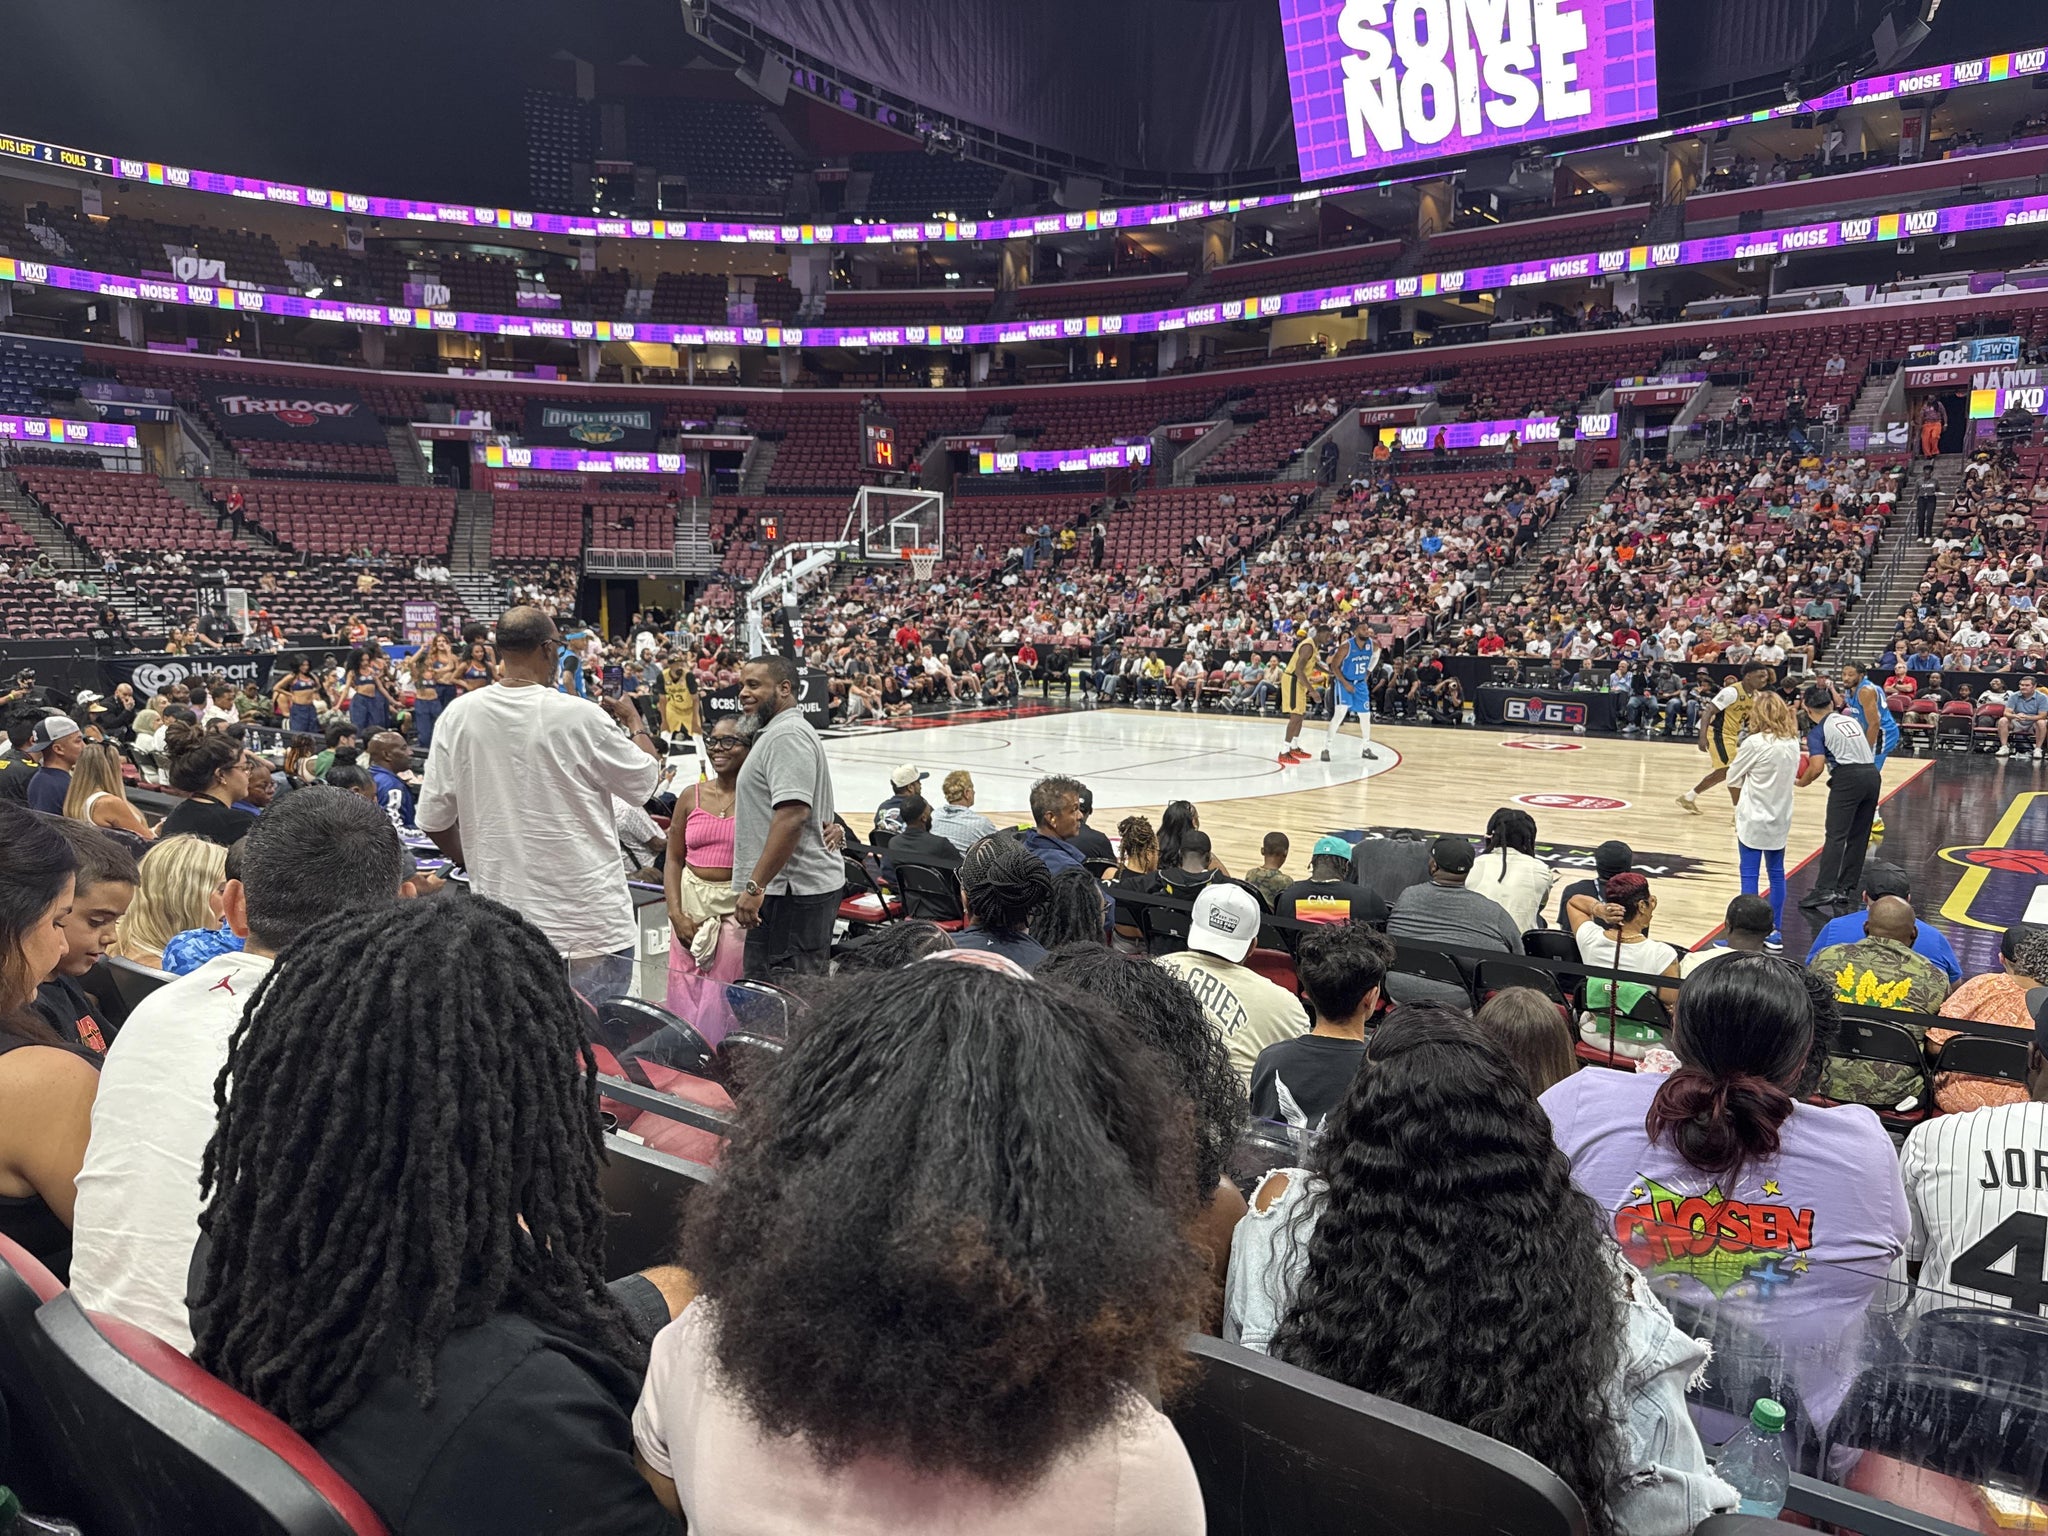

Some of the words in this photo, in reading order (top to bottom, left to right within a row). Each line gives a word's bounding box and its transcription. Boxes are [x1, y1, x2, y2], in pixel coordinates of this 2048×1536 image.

[1338, 0, 1588, 79] SOME
[2014, 51, 2046, 71] MXD
[1954, 61, 1983, 80] MXD
[1898, 73, 1942, 93] NOISE
[1343, 43, 1591, 158] NOISE
[16, 142, 35, 156] LEFT
[44, 147, 52, 161] 2
[61, 151, 86, 167] FOULS
[94, 158, 102, 171] 2
[120, 161, 143, 176] MXD
[167, 168, 189, 184] MXD
[267, 187, 300, 202] NOISE
[438, 208, 469, 222] NOISE
[1905, 211, 1937, 232] MXD
[1841, 219, 1871, 238] MXD
[1782, 229, 1828, 249] NOISE
[1599, 251, 1624, 269] MXD
[1652, 244, 1679, 263] MXD
[20, 262, 47, 279] MXD
[1550, 259, 1588, 277] NOISE
[1440, 271, 1464, 288] MXD
[140, 284, 178, 300] NOISE
[188, 286, 213, 301] MXD
[238, 291, 263, 308] MXD
[1354, 285, 1387, 302] NOISE
[346, 307, 381, 322] NOISE
[1187, 308, 1216, 324] NOISE
[532, 322, 564, 336] NOISE
[705, 329, 736, 343] NOISE
[870, 331, 899, 343] NOISE
[1028, 324, 1057, 338] NOISE
[1911, 373, 1931, 385] 118
[221, 396, 352, 416] TRILOGY
[2004, 389, 2044, 410] MXD
[1526, 422, 1560, 440] NOIS
[1581, 415, 1610, 432] MXD
[1401, 427, 1427, 445] MXD
[876, 441, 892, 466] 14
[1090, 451, 1119, 467] NOISE
[614, 456, 649, 470] NOISE
[766, 526, 776, 539] 14
[1355, 663, 1366, 675] 15
[717, 698, 734, 710] CBS
[1841, 723, 1855, 735] 11
[1307, 894, 1336, 906] CASA
[1187, 966, 1248, 1036] GRIEF
[1614, 1196, 1815, 1269] CHOSEN
[1950, 1210, 2048, 1316] 4
